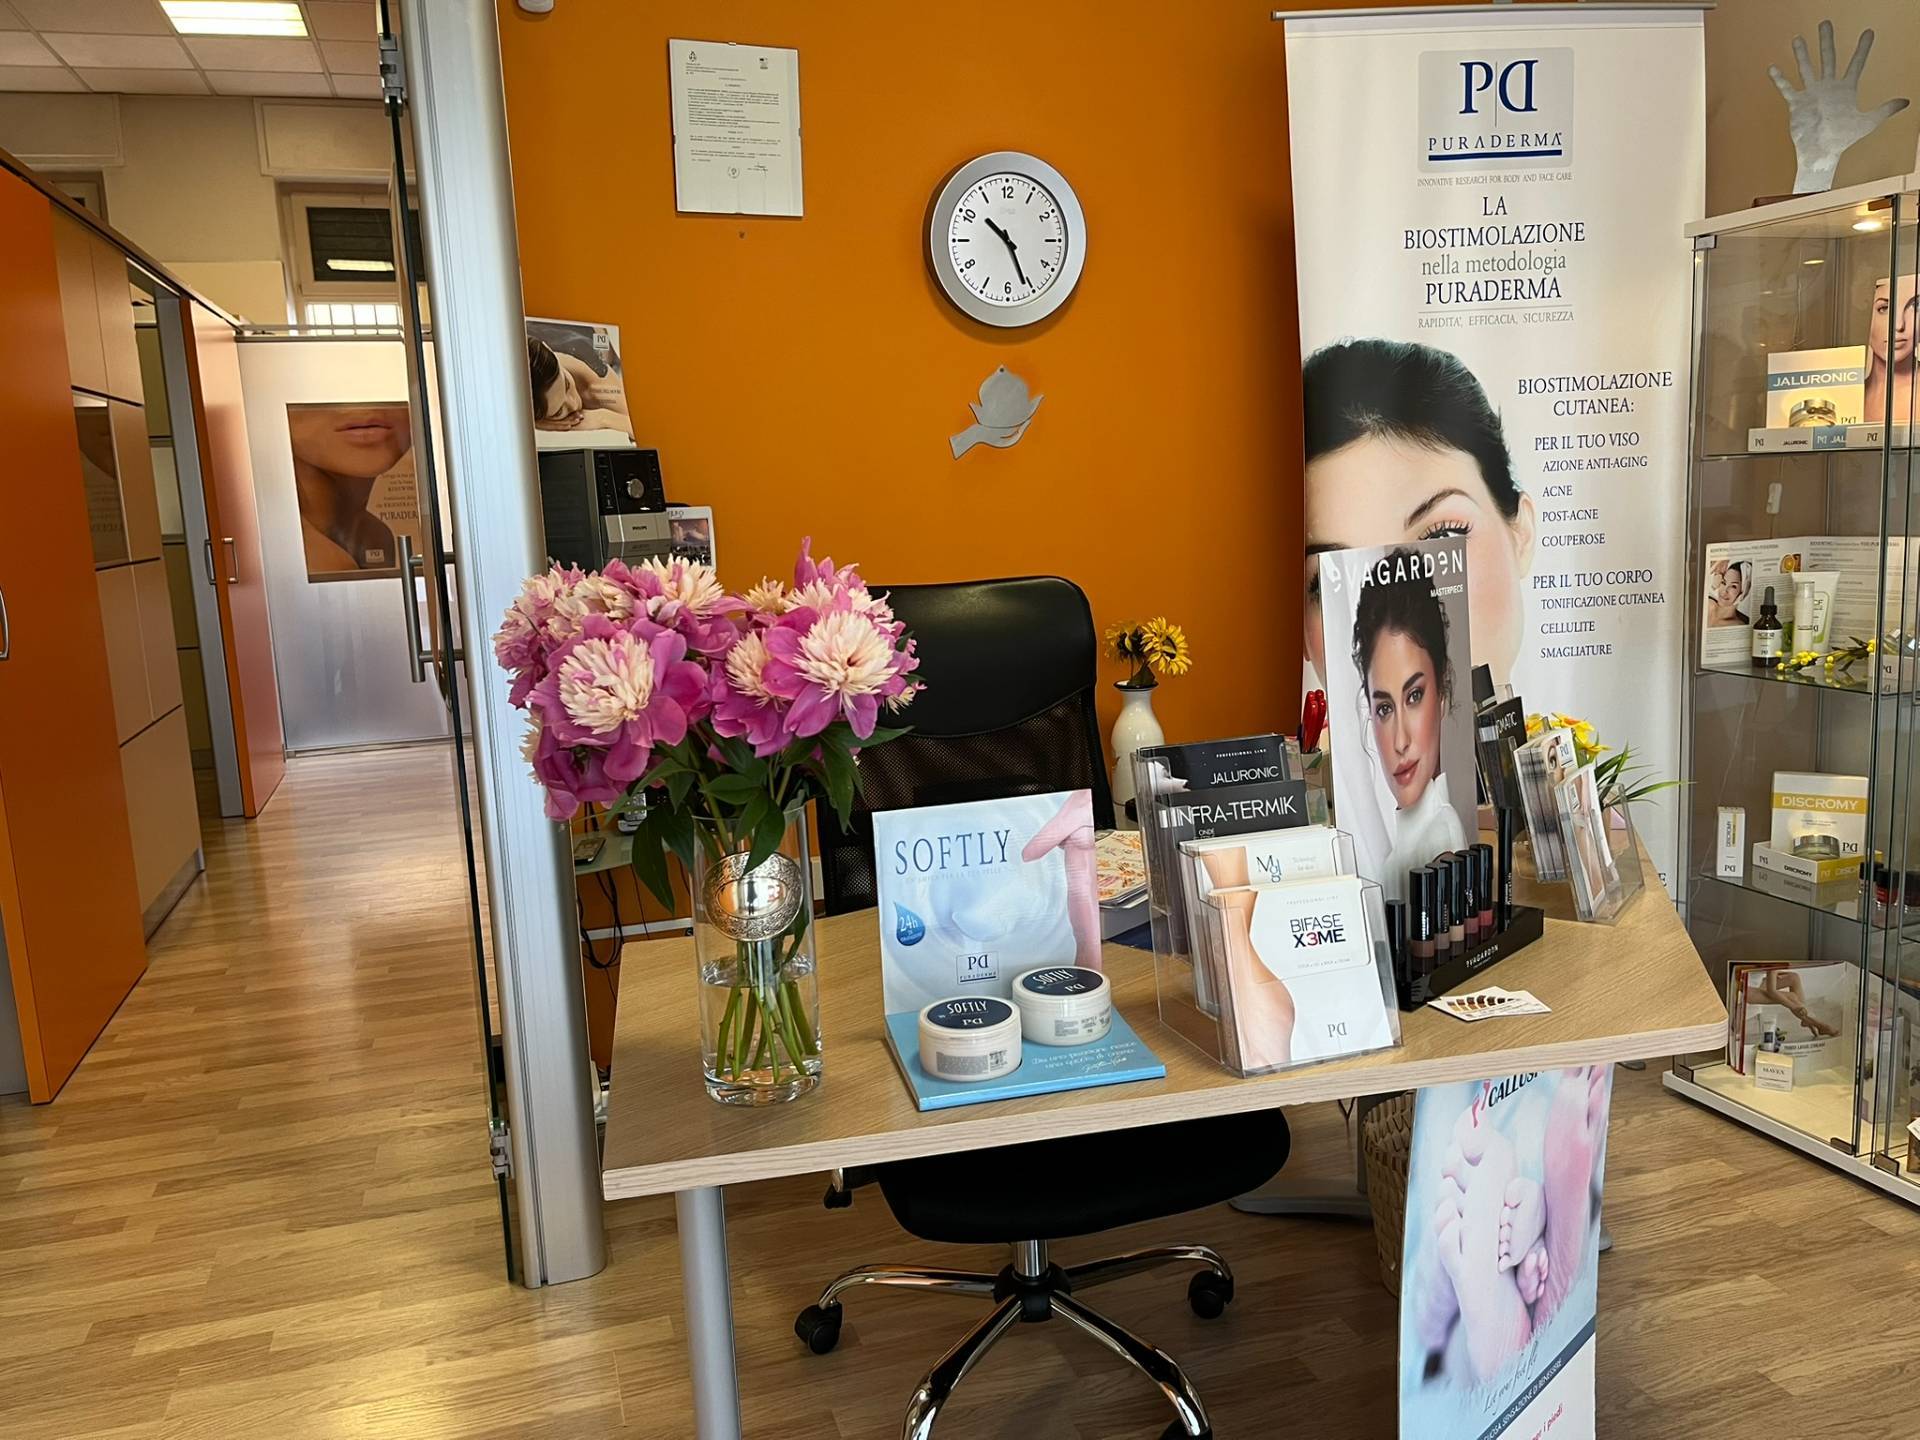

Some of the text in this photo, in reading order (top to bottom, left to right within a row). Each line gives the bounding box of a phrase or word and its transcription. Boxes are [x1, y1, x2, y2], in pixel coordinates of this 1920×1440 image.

[1428, 132, 1562, 151] PURADERMA
[1456, 175, 1488, 186] RESEARCH
[1489, 175, 1502, 184] FOR
[1503, 174, 1520, 183] BODY
[1523, 173, 1537, 182] AND
[1539, 172, 1554, 181] FACE
[1555, 172, 1573, 181] CARE
[1001, 186, 1014, 199] 12
[1482, 196, 1508, 217] LA
[963, 209, 976, 223] 10
[1039, 211, 1050, 222] 2
[1403, 222, 1586, 250] BIOSTIMOLAZIONE
[964, 258, 976, 269] 8
[1040, 259, 1051, 269] 4
[1421, 249, 1567, 277] nella metodologia
[1004, 281, 1012, 294] 6
[1425, 276, 1562, 305] PURADERMA
[1523, 311, 1574, 324] SICUREZZA
[1518, 371, 1673, 395] BIOSTIMOLAZIONE
[1772, 372, 1858, 387] JALURONIC
[1553, 397, 1635, 416] CUTANEA:
[1535, 431, 1640, 452] PER IL TUO VISO
[1543, 455, 1648, 472] AZIONE ANTI-AGING
[1542, 485, 1573, 498] ACNE
[1542, 509, 1599, 522] POST-ACNE
[1541, 533, 1606, 547] COUPEROSE
[1533, 569, 1652, 590] PER IL TUO CORPO
[1430, 584, 1464, 597] MASTERPIECE
[1540, 592, 1665, 610] TONIFICAZIONE CUTANEA
[1540, 620, 1595, 634] CELLULITE
[1540, 644, 1612, 659] SMAGLIATURE
[1210, 766, 1280, 785] JALURONIC
[1174, 795, 1297, 827] INFRA-TERMIK
[1781, 796, 1858, 810] DISCROMY
[895, 829, 1011, 876] SOFTLY
[1784, 865, 1812, 877] DISCROMY
[899, 915, 919, 932] 24h
[1290, 913, 1343, 933] BIFASE
[1293, 928, 1346, 948] X3ME
[1032, 968, 1075, 986] SOFTLY
[946, 1000, 988, 1015] SOFTLY
[1488, 1072, 1539, 1107] CALLUS
